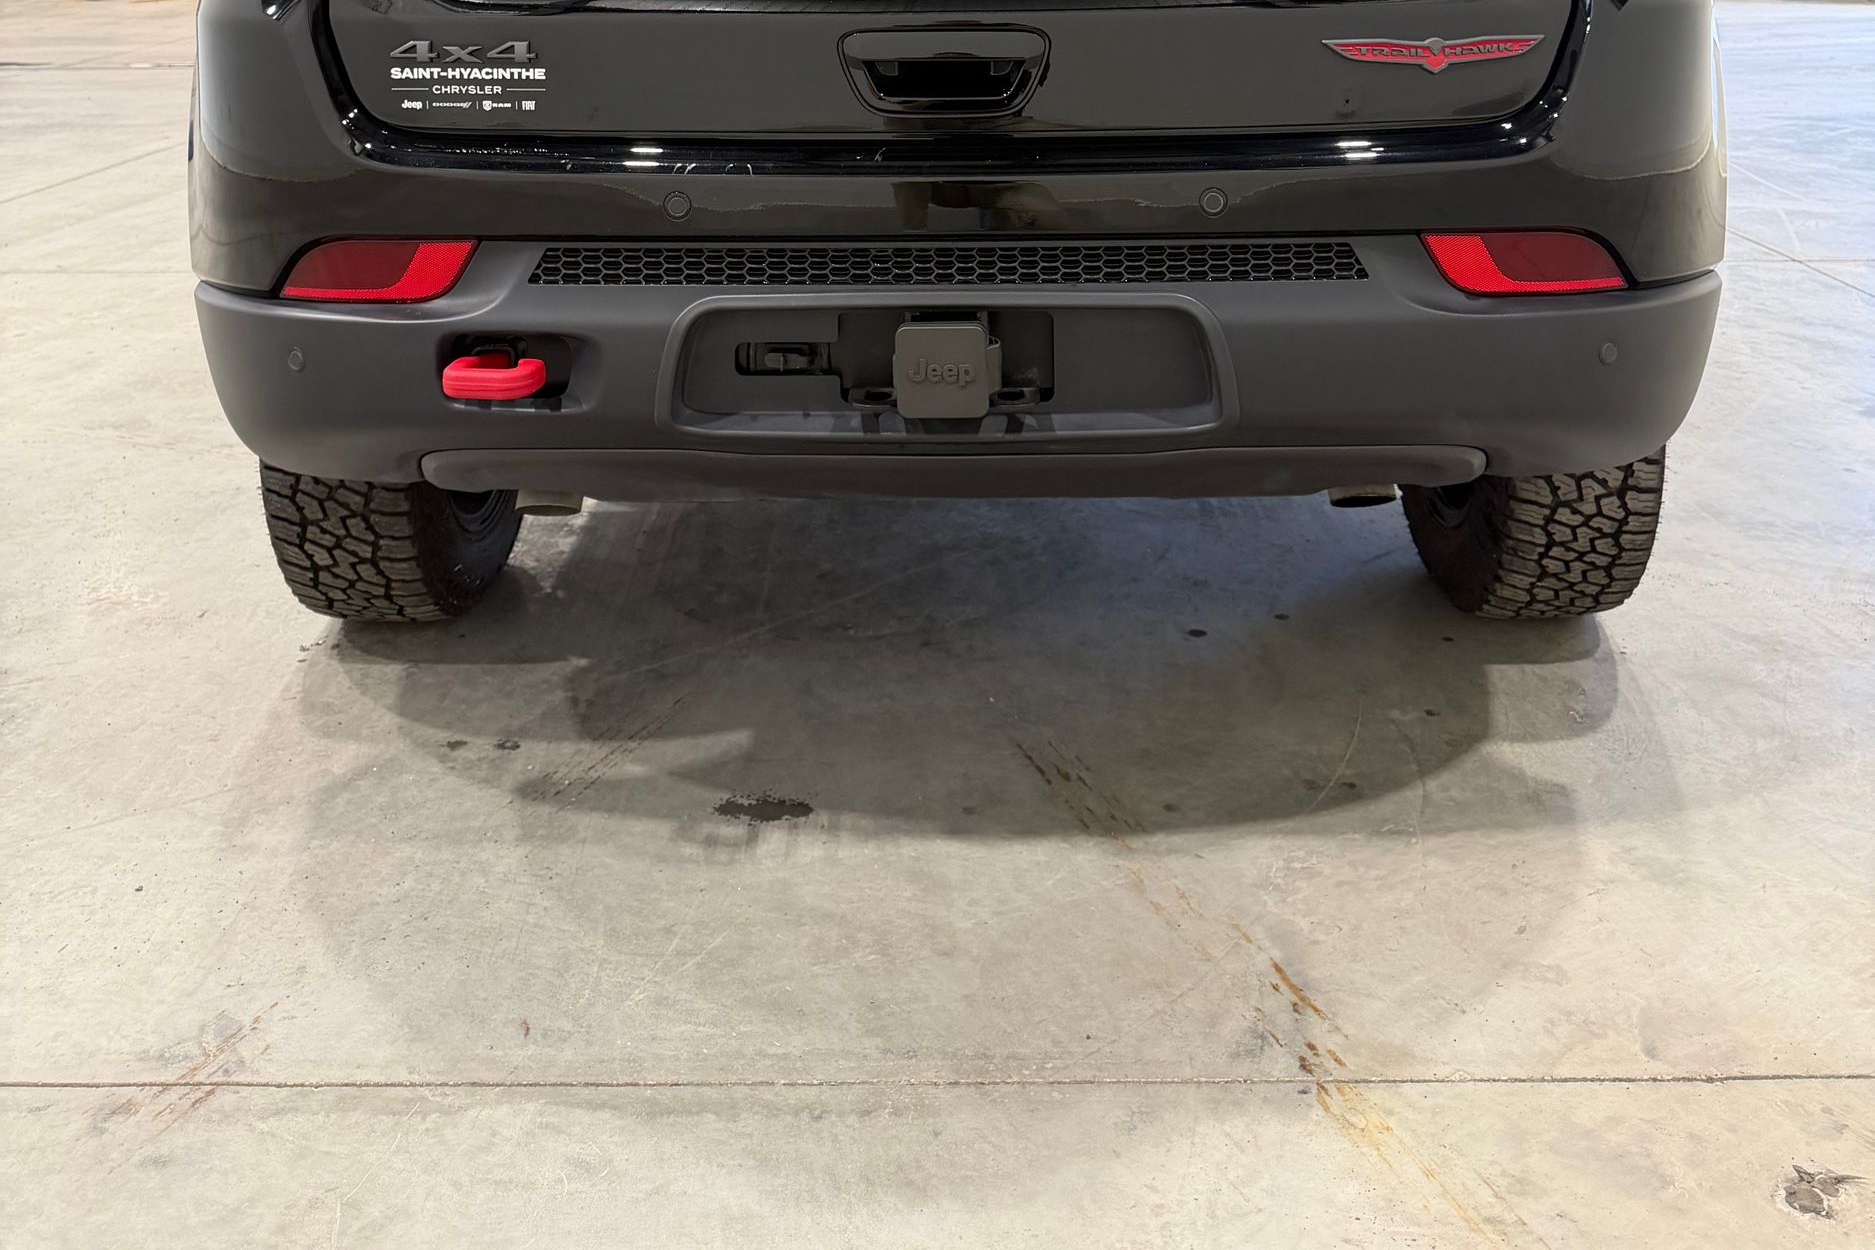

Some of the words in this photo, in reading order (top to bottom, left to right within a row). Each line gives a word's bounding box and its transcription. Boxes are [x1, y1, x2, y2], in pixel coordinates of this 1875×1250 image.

[390, 67, 546, 80] SAINT-HYACINTHE
[432, 85, 502, 95] CHRYSLER
[401, 99, 423, 110] Jeep
[522, 100, 536, 111] FIAT
[908, 358, 975, 387] Jeep
